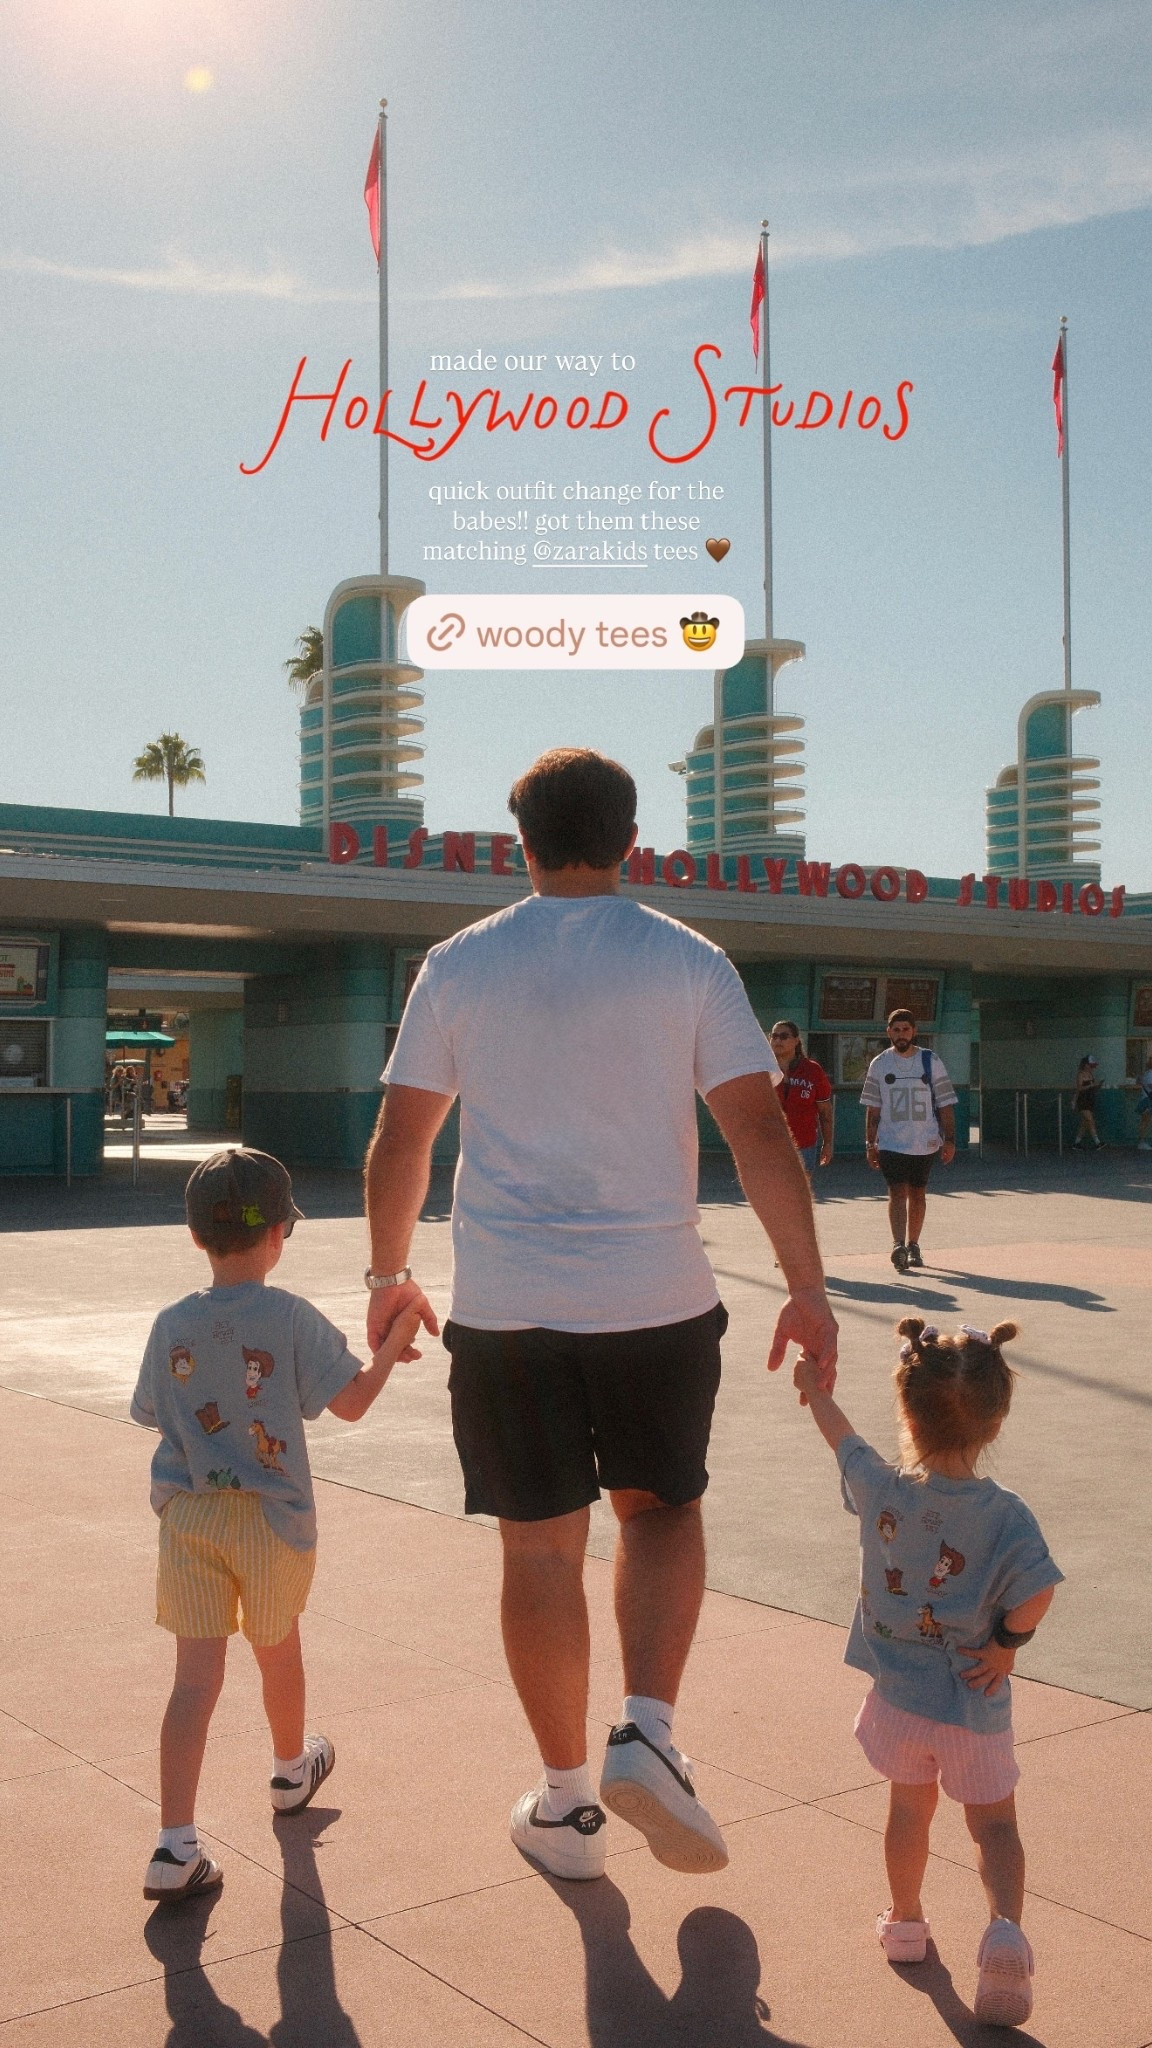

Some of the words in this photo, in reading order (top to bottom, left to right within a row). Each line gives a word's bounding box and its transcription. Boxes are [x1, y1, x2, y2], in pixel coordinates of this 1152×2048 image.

[329, 821, 517, 876] DISNE
[627, 846, 929, 904] HOLLYWOOD
[956, 872, 1126, 918] STUDIOS
[889, 1087, 928, 1122] 06
